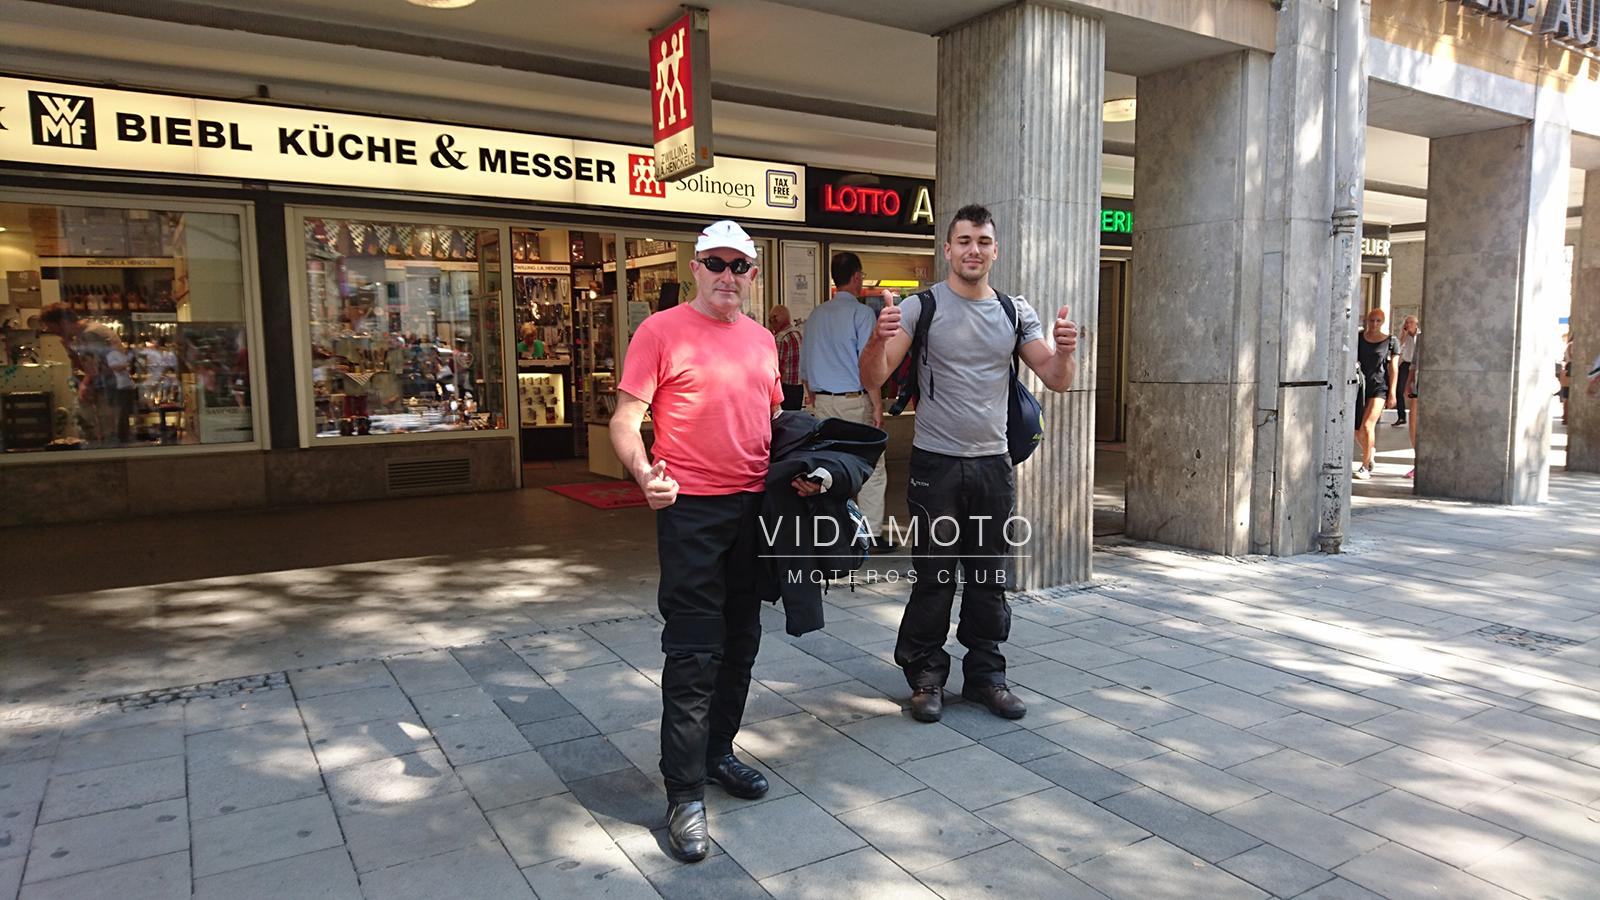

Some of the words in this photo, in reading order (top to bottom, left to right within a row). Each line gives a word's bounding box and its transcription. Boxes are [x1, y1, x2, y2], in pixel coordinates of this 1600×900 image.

[1541, 0, 1600, 46] AU
[37, 95, 87, 146] WMF
[116, 112, 253, 151] BIEBL
[278, 124, 418, 165] KÜCHE
[429, 133, 469, 170] &
[478, 147, 617, 184] MESSER
[660, 143, 688, 165] ZWILLING
[665, 152, 696, 174] HENCKELS
[773, 186, 790, 196] FREE
[774, 177, 789, 188] TAX
[824, 184, 901, 216] LOTTO
